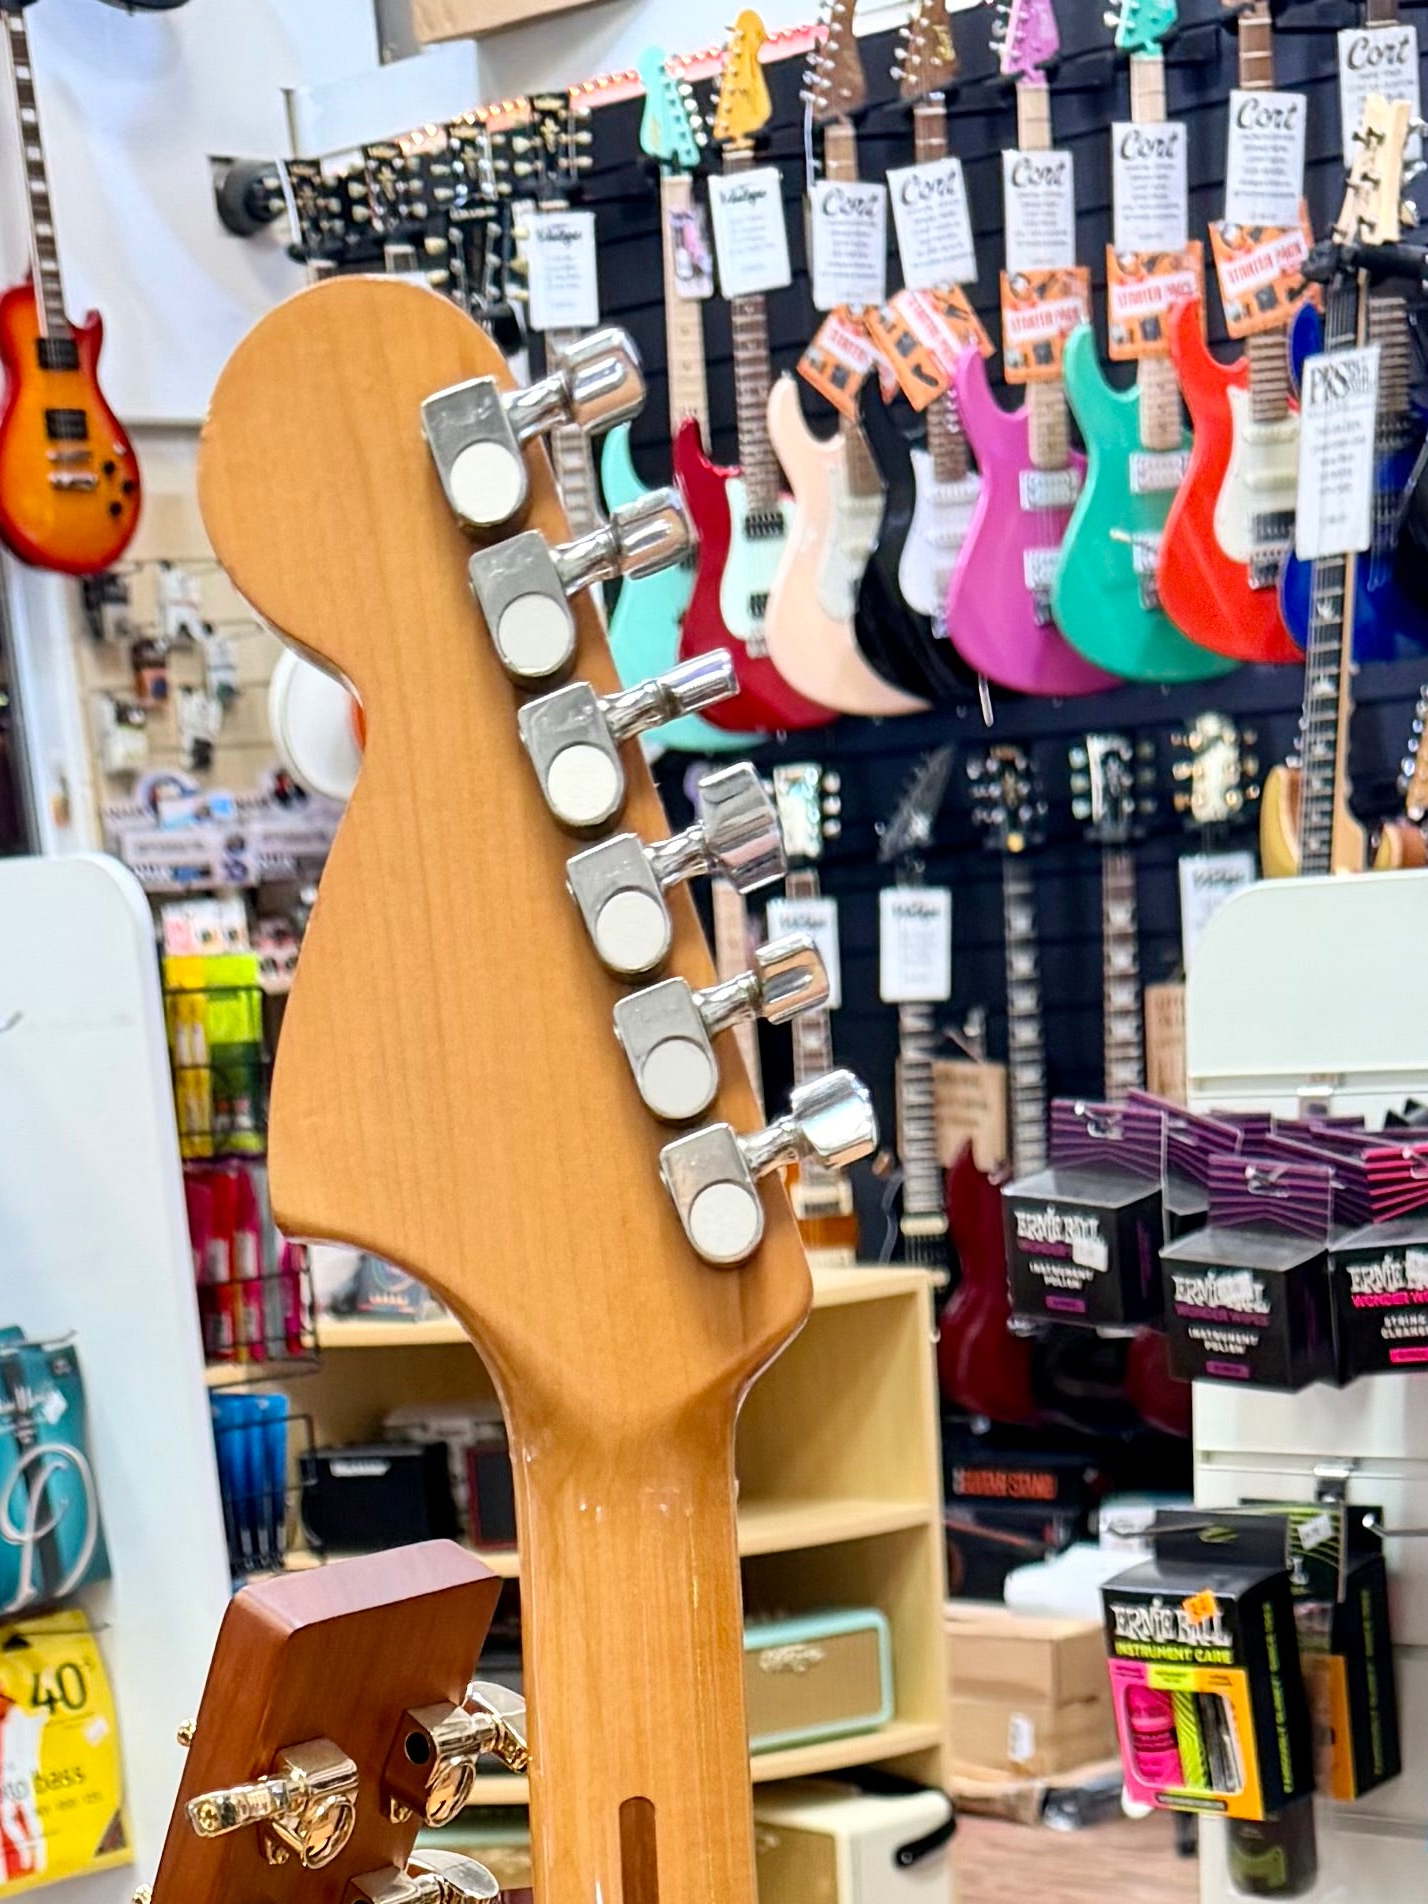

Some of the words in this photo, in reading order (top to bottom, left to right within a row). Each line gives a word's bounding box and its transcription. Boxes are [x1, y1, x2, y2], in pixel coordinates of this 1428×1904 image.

[1347, 30, 1410, 72] Cort
[1236, 98, 1298, 130] Cort
[1120, 130, 1179, 161] Cort
[1011, 157, 1066, 189] Cort
[1351, 1290, 1410, 1308] WONDER
[1109, 1597, 1173, 1643] ERNIE
[1114, 1641, 1193, 1663] INSTRUMENT
[1194, 1646, 1235, 1665] CARE
